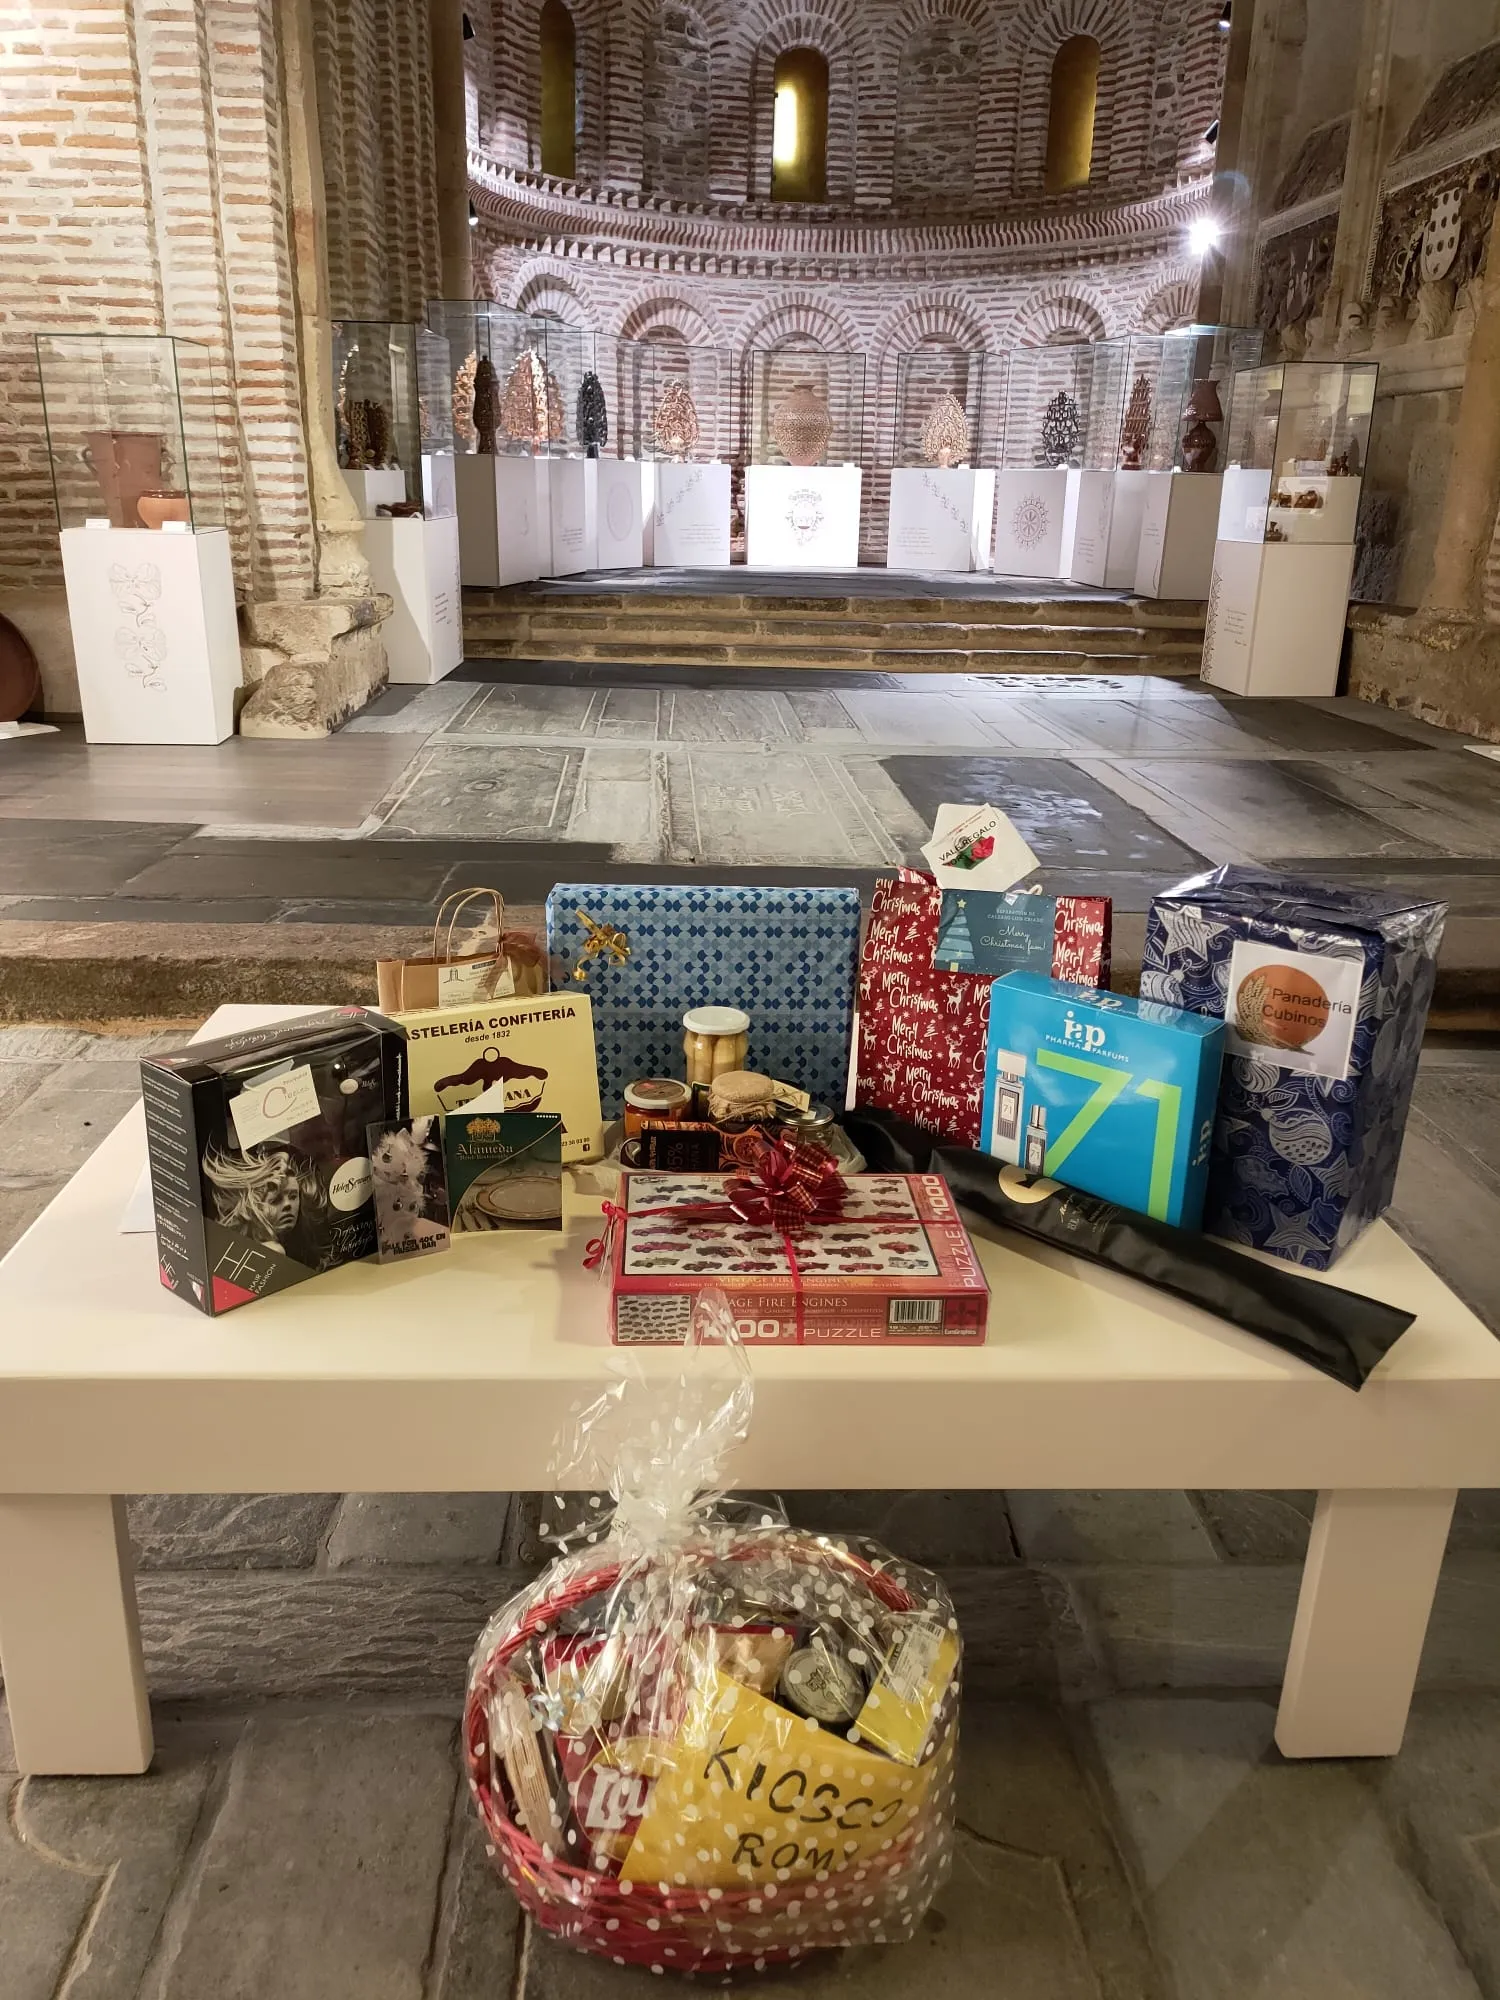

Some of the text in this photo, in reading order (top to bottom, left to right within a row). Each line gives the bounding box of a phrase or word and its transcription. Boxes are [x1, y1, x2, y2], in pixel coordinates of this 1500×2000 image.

[938, 841, 962, 862] VALE
[962, 820, 997, 847] REGALO
[875, 878, 894, 897] erry
[871, 890, 921, 915] Christmas
[1055, 897, 1075, 917] erry
[870, 920, 899, 945] Merry
[998, 925, 1030, 943] Merry
[1054, 910, 1103, 936] Christmas
[862, 940, 913, 965] Christmas
[1055, 941, 1084, 968] Merry
[882, 971, 910, 993] Merry
[889, 987, 938, 1013] Christmas
[1272, 988, 1352, 1015] Panadería
[404, 1005, 576, 1041] STELERÍA CONFITERÍA
[892, 1014, 918, 1041] Merry
[1262, 1004, 1326, 1028] Cubinos
[465, 1030, 511, 1044] desde 1832
[887, 1034, 933, 1060] Christmas
[1045, 1034, 1129, 1063] PHARMA PARFUMS
[905, 1065, 931, 1089] Merry
[912, 1081, 959, 1109] Christmas
[914, 1109, 940, 1136] Merry
[921, 1175, 951, 1216] 1000
[945, 1229, 982, 1288] PUZZLE
[248, 1273, 262, 1292] HAIR
[254, 1263, 276, 1295] FASHION
[758, 1296, 786, 1308] FIRE
[804, 1327, 881, 1338] PUZZLE
[704, 1731, 904, 1830] KIOSCO
